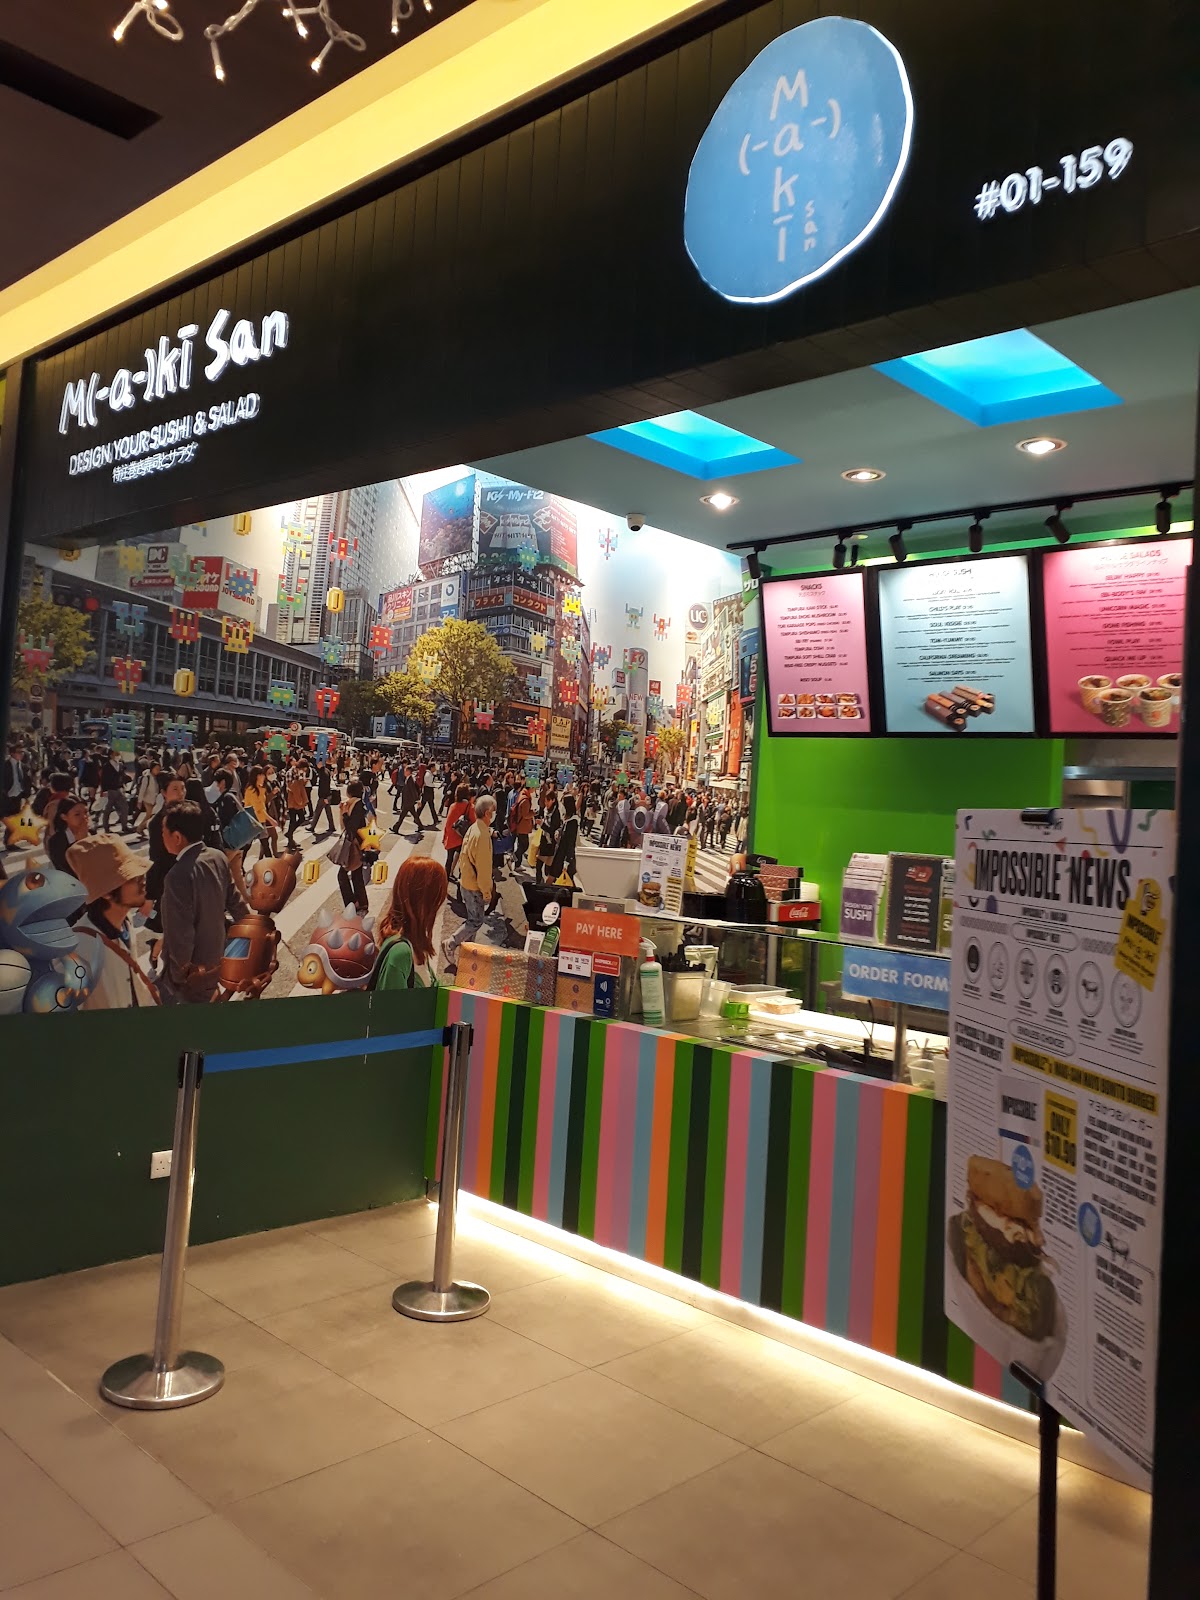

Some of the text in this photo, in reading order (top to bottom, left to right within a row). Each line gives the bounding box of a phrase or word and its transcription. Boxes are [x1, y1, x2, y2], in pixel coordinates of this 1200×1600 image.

[973, 137, 1134, 221] #01-159
[205, 308, 290, 381] San
[69, 393, 261, 475] DESIGN YOUR SUSHI & SALAD
[1069, 857, 1131, 910] NEWS
[576, 923, 623, 940] PAY HERE
[844, 908, 872, 921] SUSHI
[849, 963, 899, 985] ORDER
